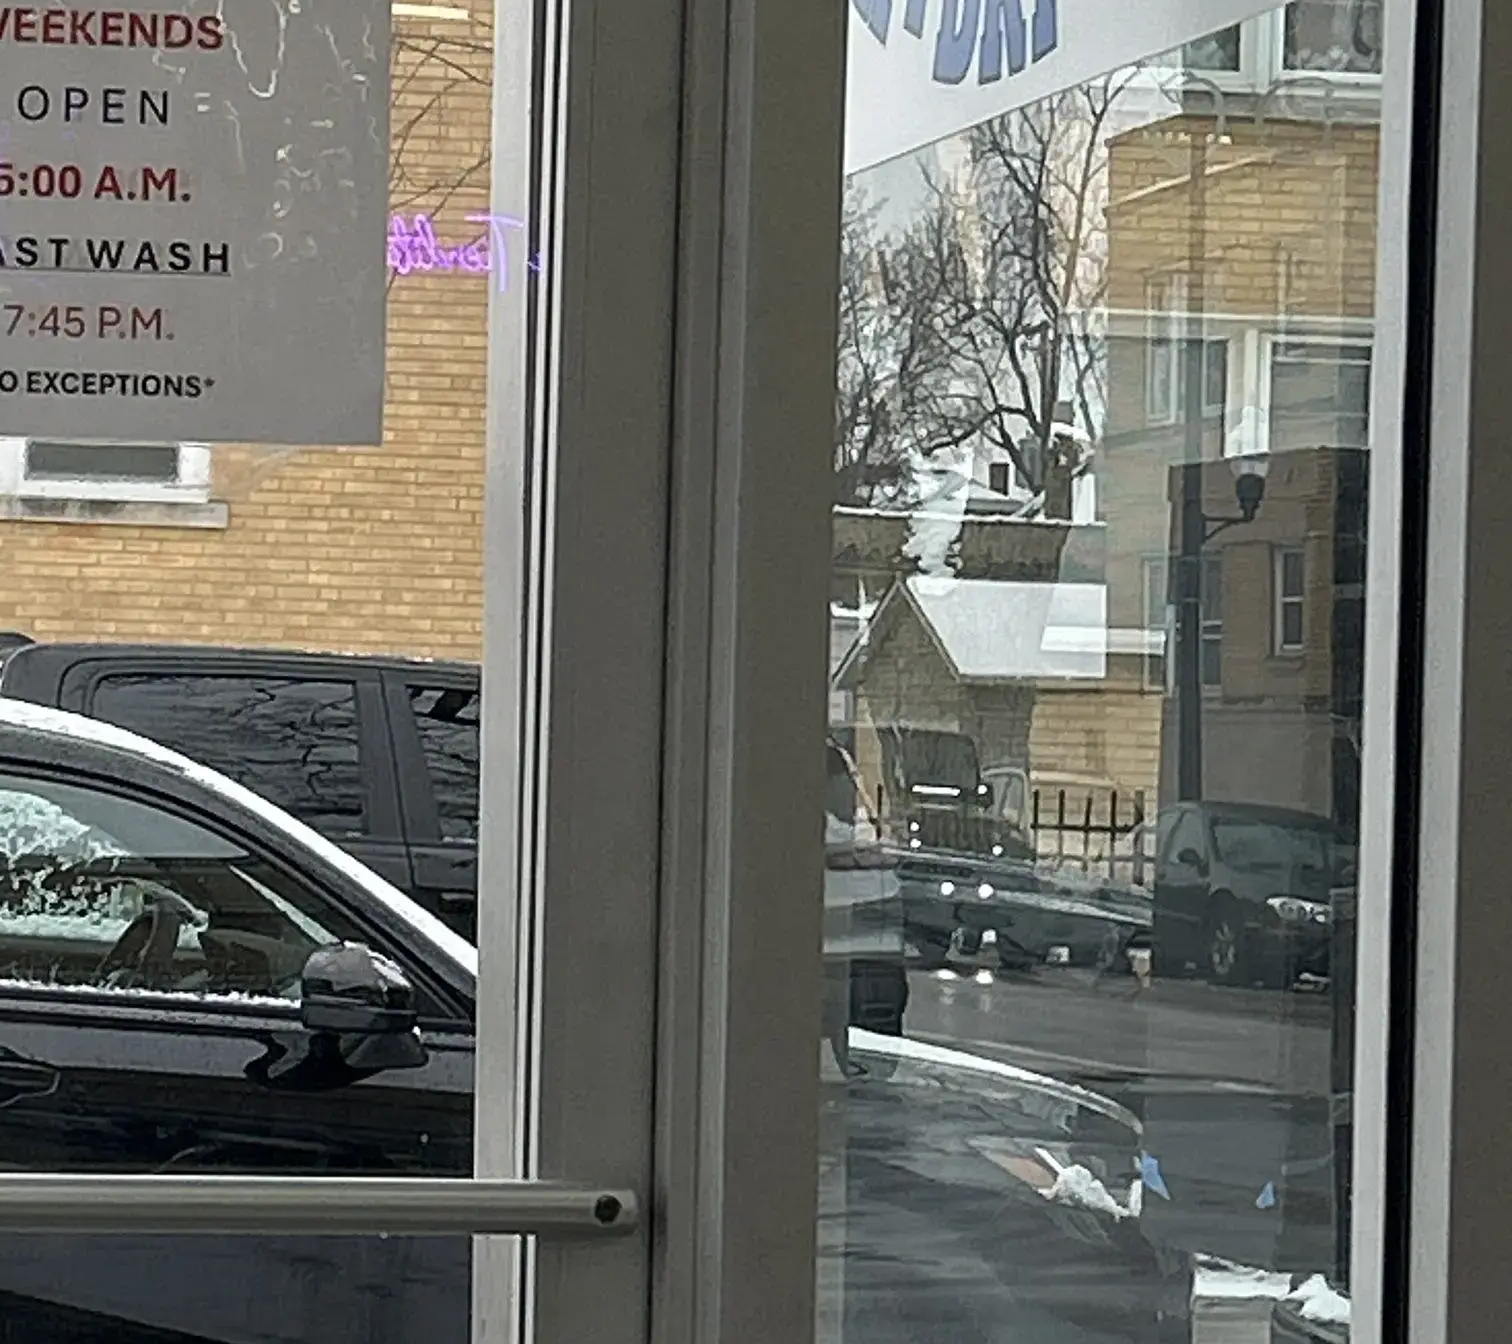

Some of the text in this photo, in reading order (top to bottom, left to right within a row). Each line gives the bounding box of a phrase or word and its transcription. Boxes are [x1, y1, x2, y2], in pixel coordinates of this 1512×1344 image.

[18, 86, 168, 125] OPEN
[94, 165, 192, 202] A.M.
[87, 237, 230, 274] WASH
[3, 304, 175, 340] 7:45 P.M.
